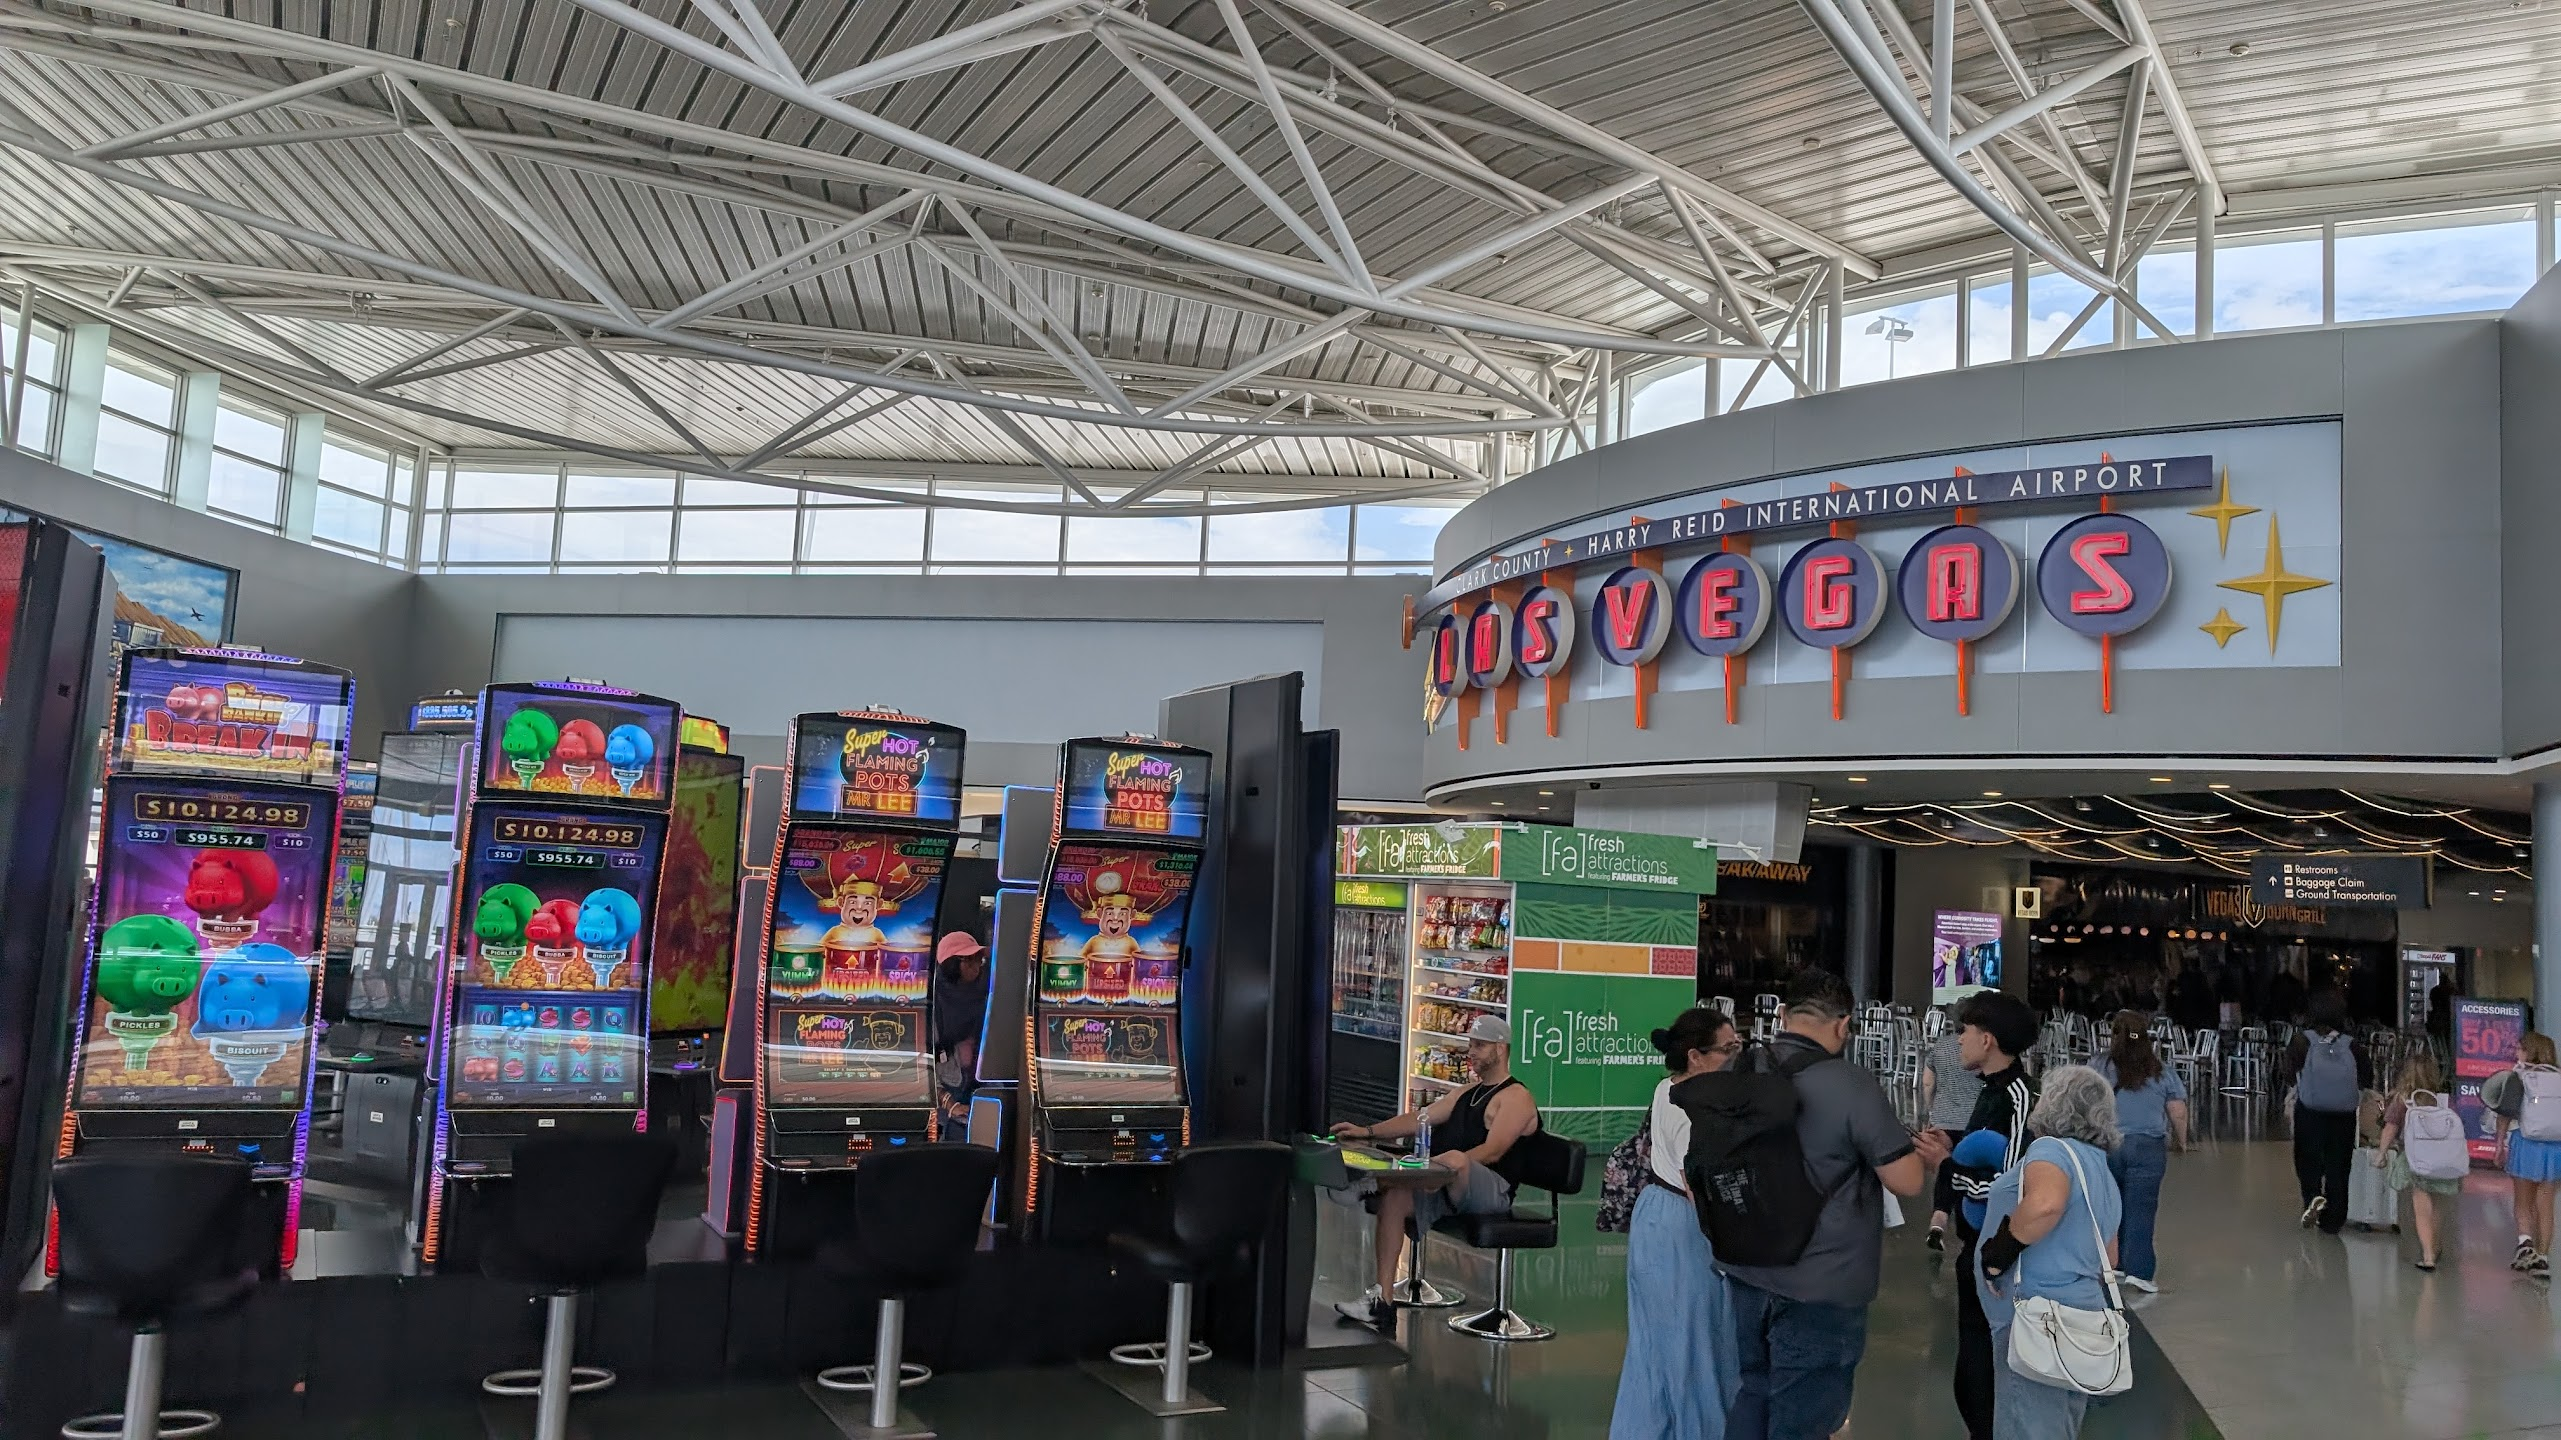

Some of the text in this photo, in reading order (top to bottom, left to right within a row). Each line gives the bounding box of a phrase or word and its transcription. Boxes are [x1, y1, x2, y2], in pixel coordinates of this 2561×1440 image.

[1456, 461, 2168, 594] CLARK COUNTY HARRY REID INTERNATIONAL AIRPORT
[1438, 531, 2134, 684] LAS VEGAS
[146, 709, 316, 762] BREAK IN
[843, 728, 888, 758] Super
[882, 738, 920, 755] HOT
[845, 752, 918, 772] FLAMING
[1106, 751, 1145, 780] Super
[1140, 760, 1173, 777] HOT
[855, 770, 910, 792] POTS
[1108, 774, 1172, 793] FLAMING
[845, 789, 912, 812] MR LEE
[1116, 791, 1165, 812] POTS
[1108, 809, 1166, 829] MR LEE
[187, 832, 254, 846] $955.74
[1405, 829, 1430, 848] fresh
[1588, 833, 1625, 854] fresh
[842, 839, 878, 855] Super
[537, 853, 594, 865] $955.74
[1100, 855, 1130, 868] Super
[1405, 847, 1459, 864] attractions
[1420, 863, 1445, 874] FARMER'S
[1444, 864, 1467, 874] FRIDGE
[1587, 852, 1668, 875] attractions
[2295, 864, 2339, 875] Restrooms
[1587, 871, 1679, 886] featuring FARMER'S FRIDGE
[2295, 876, 2365, 889] Baggage Claim
[1354, 882, 1369, 894] fresh
[1353, 894, 1386, 906] attractions
[2296, 889, 2397, 902] Ground Transportation
[2206, 888, 2242, 919] VEGAS
[489, 949, 517, 957] PICKLES
[781, 970, 815, 979] YUMMY
[888, 970, 917, 982] SPICY
[1050, 979, 1078, 987] YUMMY
[1142, 977, 1166, 989] SPICY
[2461, 1004, 2521, 1016] ACCESSORIES
[118, 1020, 162, 1031] PICKLES
[797, 1013, 826, 1033] Super
[821, 1018, 846, 1029] HOT
[1064, 1018, 1088, 1035] Super
[1084, 1022, 1106, 1032] HOT
[1576, 1011, 1618, 1032] fresh
[799, 1030, 847, 1041] FLAMING
[1066, 1032, 1107, 1043] FLAMING
[226, 1045, 271, 1056] BISCUIT
[1071, 1042, 1104, 1054] POTS
[821, 1052, 845, 1065] LEE
[1575, 1054, 1666, 1067] featuring FARMER'S FRI
